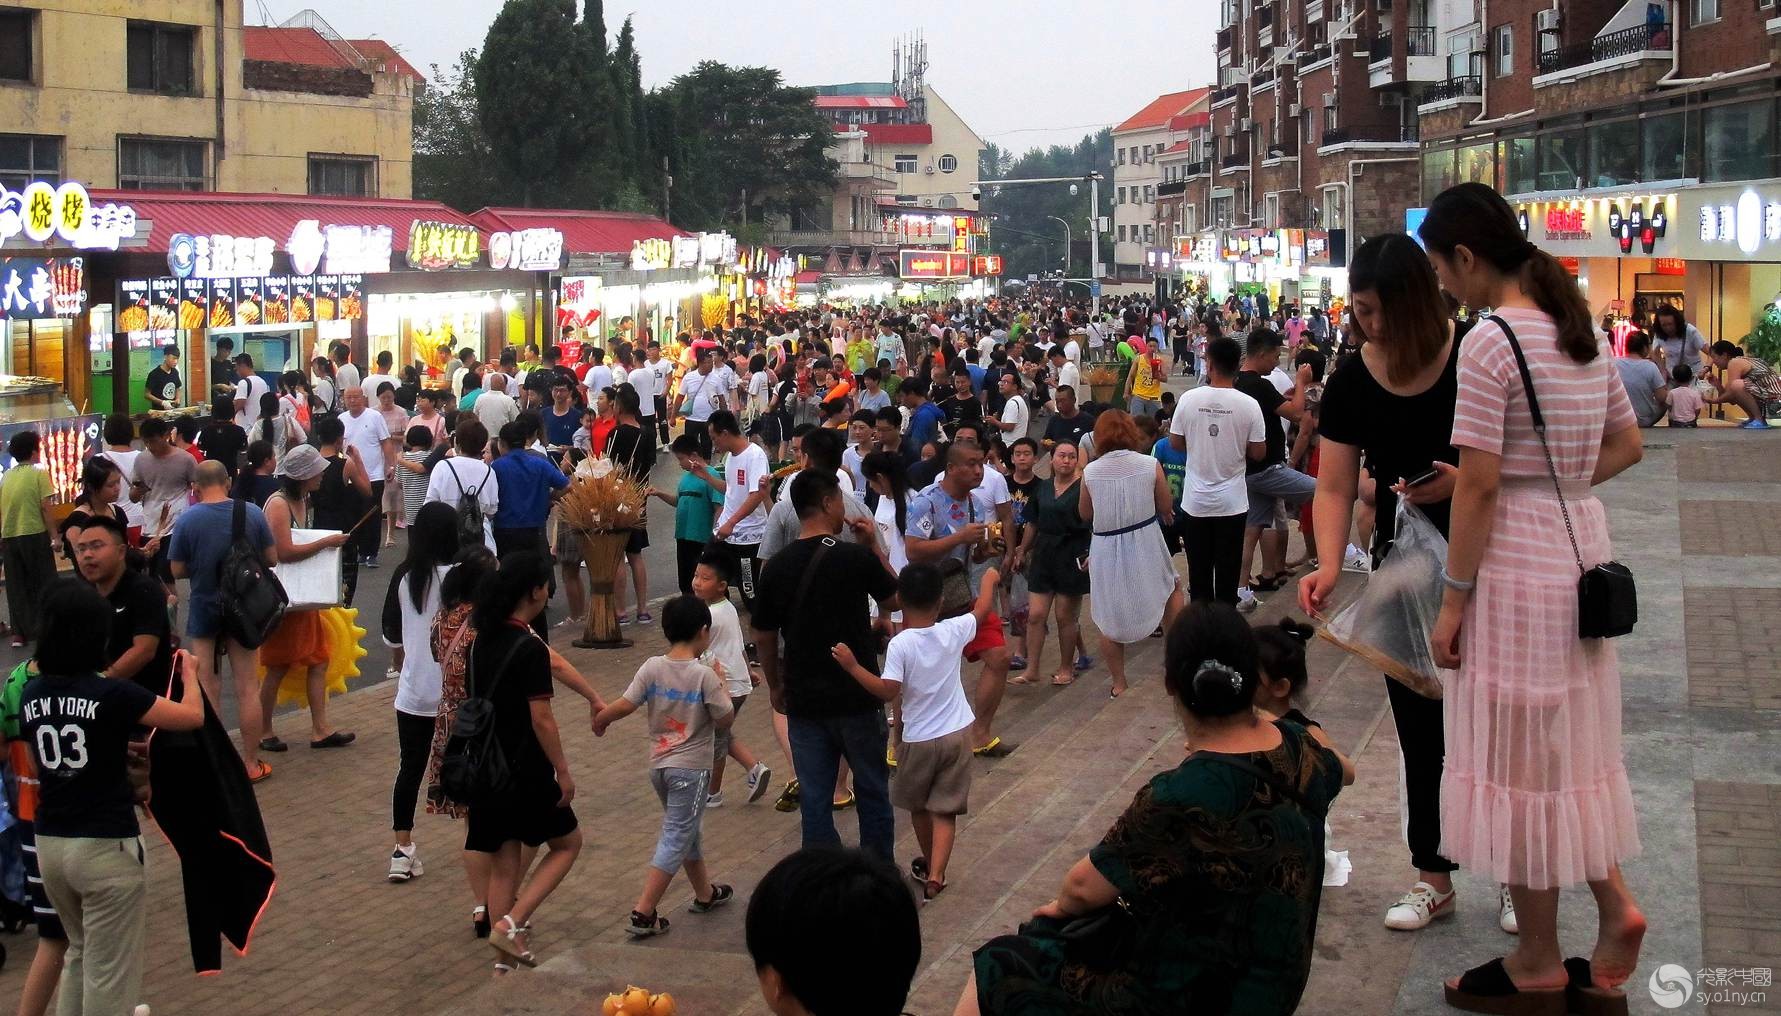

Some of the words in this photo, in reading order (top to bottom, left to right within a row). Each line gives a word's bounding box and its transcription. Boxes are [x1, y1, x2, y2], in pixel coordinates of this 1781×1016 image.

[30, 192, 83, 230] 烧烤
[24, 697, 51, 722] NEW
[58, 697, 100, 720] YORK
[36, 724, 88, 769] 03
